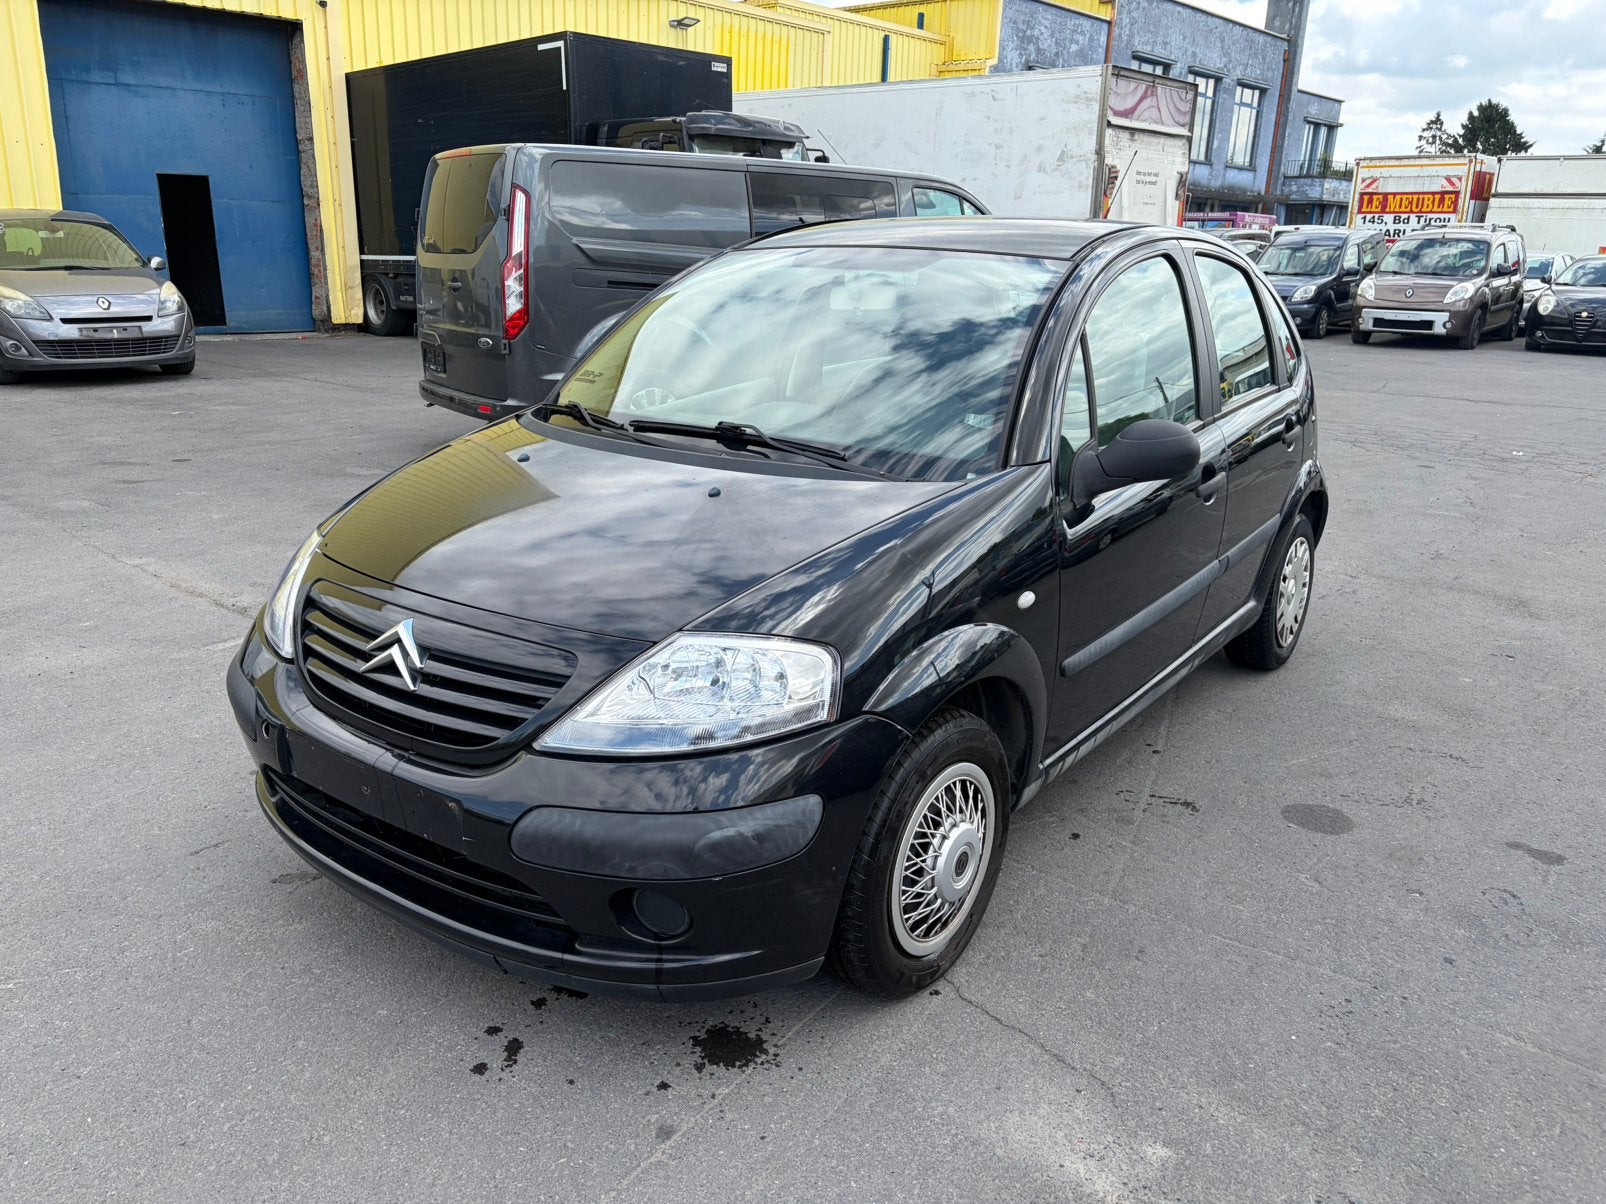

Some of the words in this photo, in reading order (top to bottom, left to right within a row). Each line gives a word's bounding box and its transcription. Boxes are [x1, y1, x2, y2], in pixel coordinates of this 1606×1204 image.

[1361, 195, 1383, 212] LE
[1386, 194, 1455, 212] MEUBLE
[1360, 215, 1388, 226] 145,
[1392, 215, 1410, 225] Bd
[1415, 215, 1451, 225] Tirou
